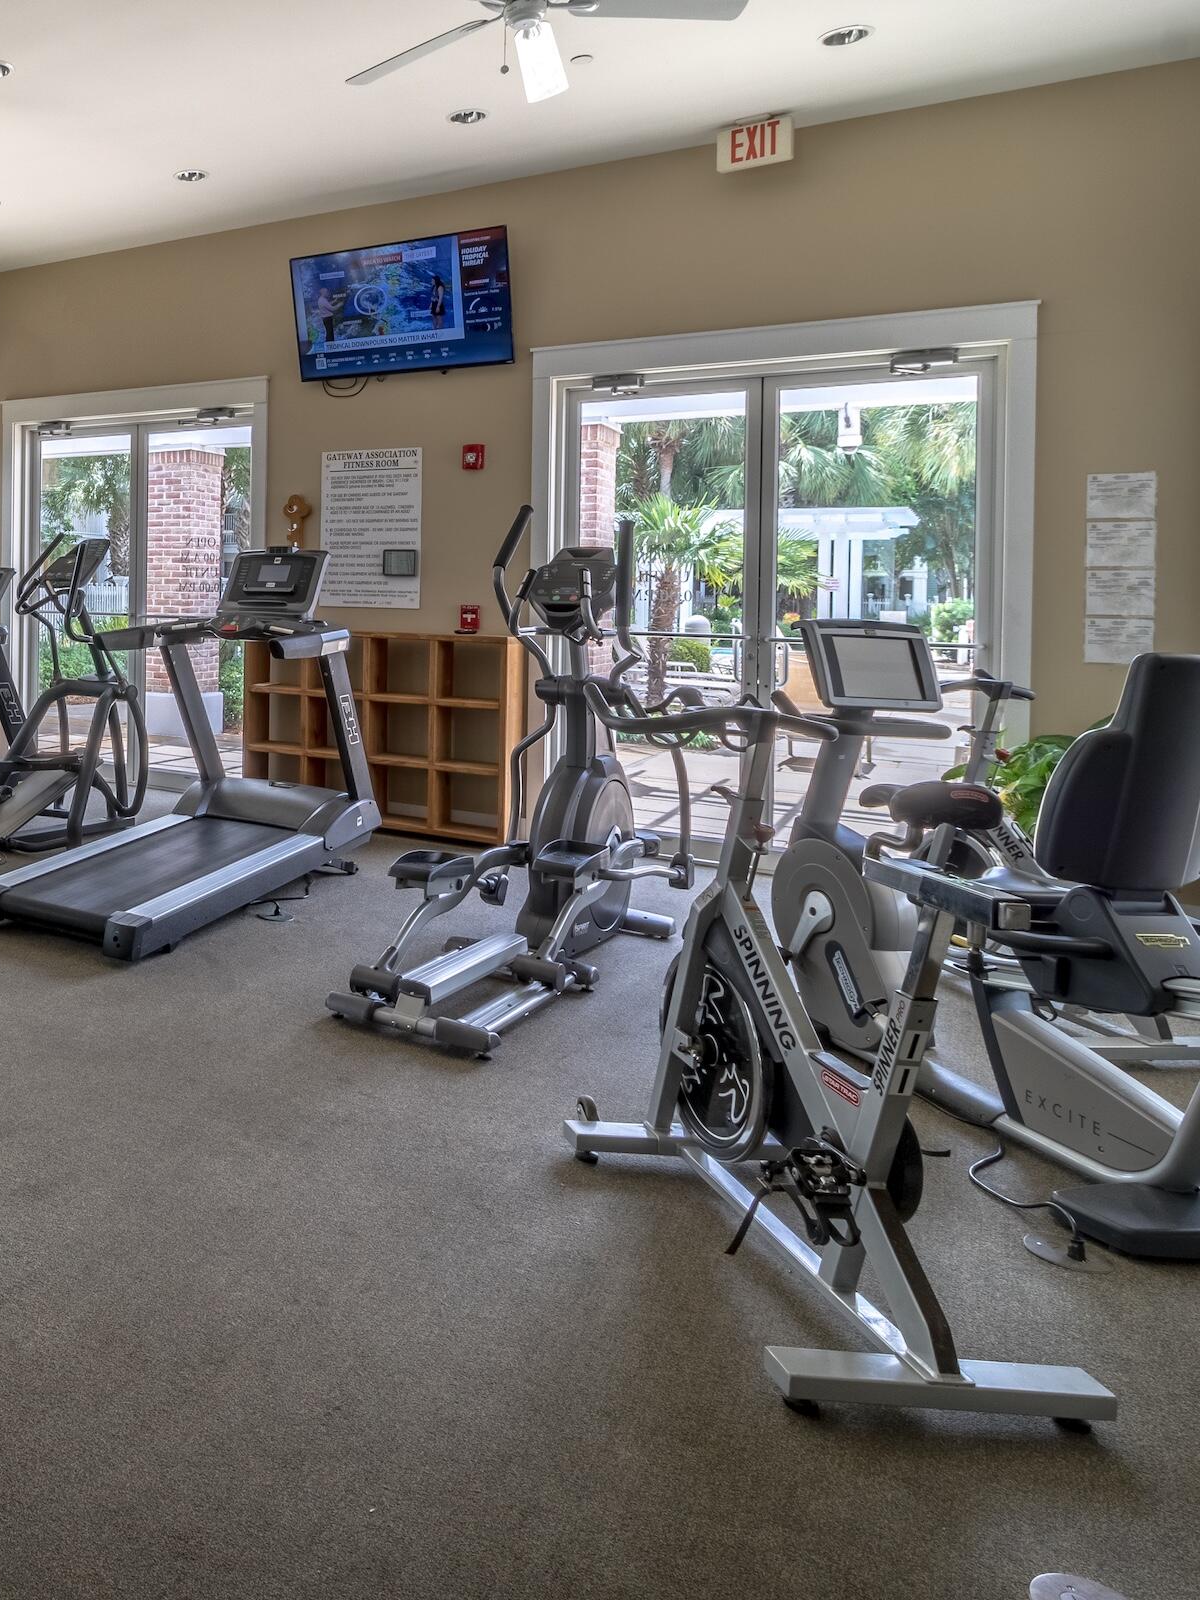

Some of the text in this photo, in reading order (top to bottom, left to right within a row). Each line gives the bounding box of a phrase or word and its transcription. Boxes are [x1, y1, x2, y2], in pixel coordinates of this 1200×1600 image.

[731, 120, 780, 164] EXIT
[461, 245, 488, 255] HOLIDAY
[462, 252, 489, 261] TROPICAL
[462, 258, 485, 267] THREAT
[351, 339, 388, 348] DOWNPOURS
[398, 335, 420, 343] MATTER
[420, 333, 438, 341] WHAT
[327, 449, 418, 461] GATEWAY ASSOCIATION
[343, 459, 399, 469] FITNESS ROOM
[992, 826, 1025, 861] NNER
[733, 924, 797, 1051] SPINNING
[873, 1000, 906, 1097] SPINNER PRO
[823, 1074, 858, 1103] STAR TRAC
[1025, 1089, 1101, 1137] EXCITE
